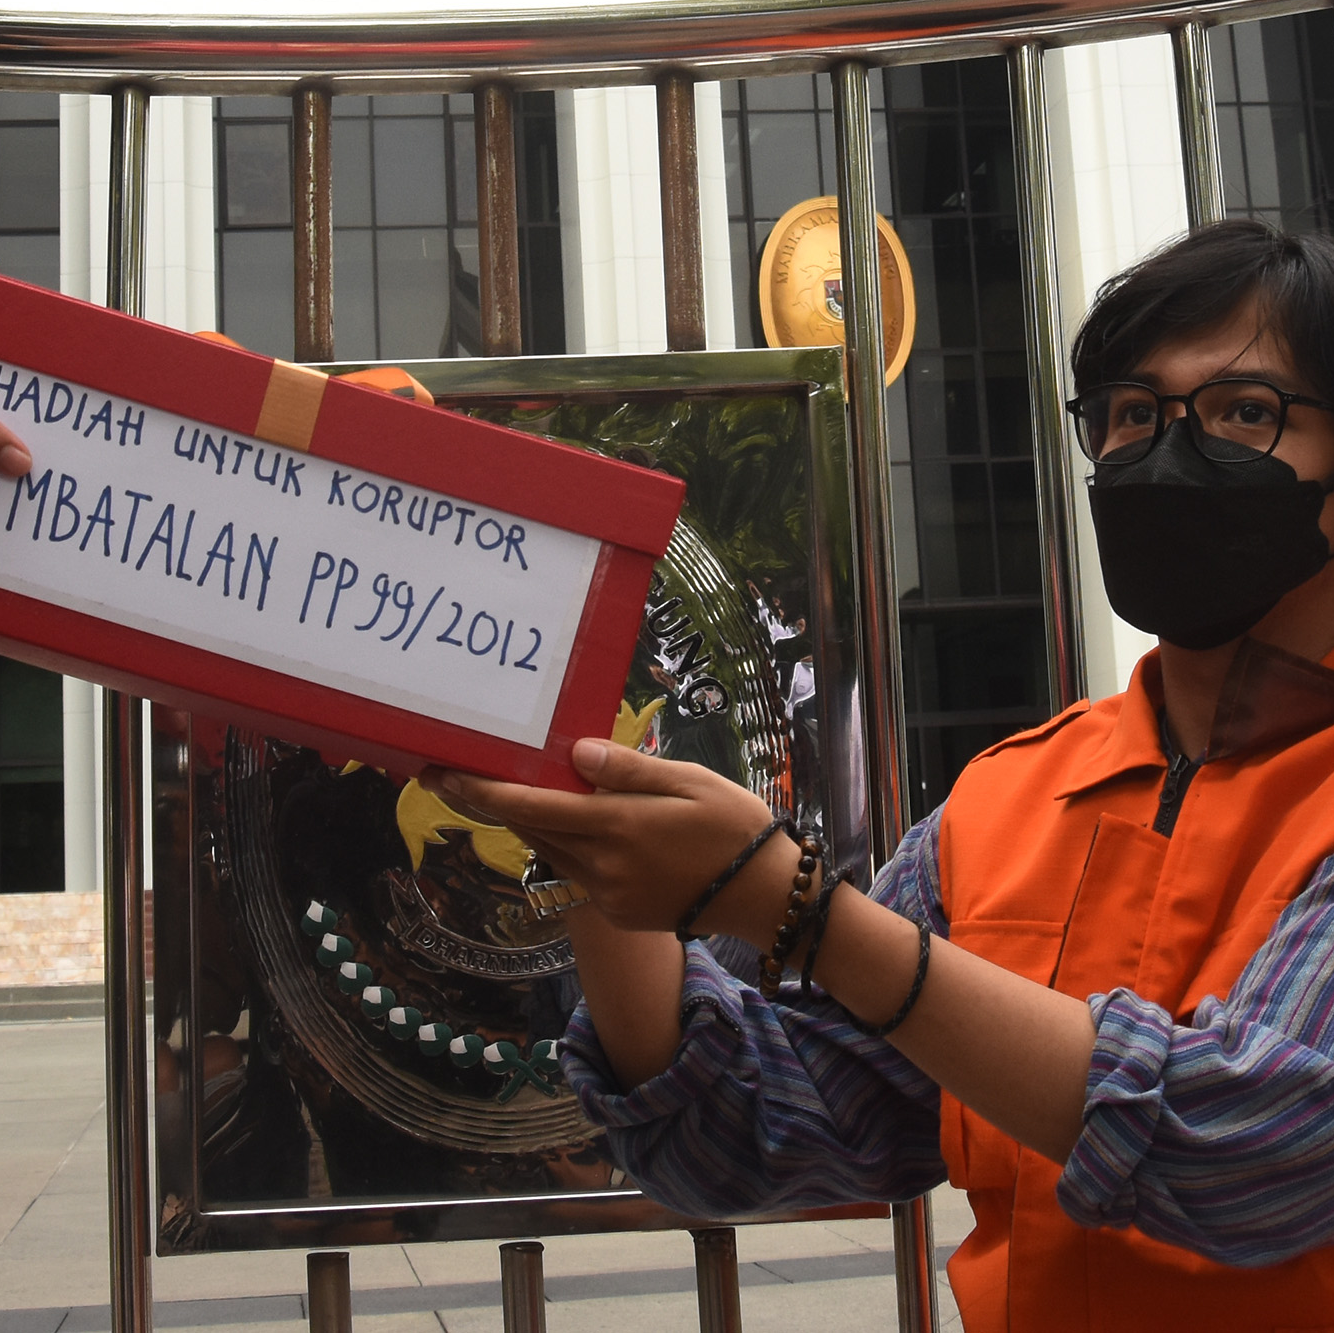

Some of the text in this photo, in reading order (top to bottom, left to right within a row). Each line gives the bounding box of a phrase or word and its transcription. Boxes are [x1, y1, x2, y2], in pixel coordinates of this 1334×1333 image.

[776, 213, 839, 284] MAHKAMA
[173, 424, 306, 497] UNTUK
[327, 469, 529, 571] KORUPTOR
[648, 569, 729, 719] UNG
